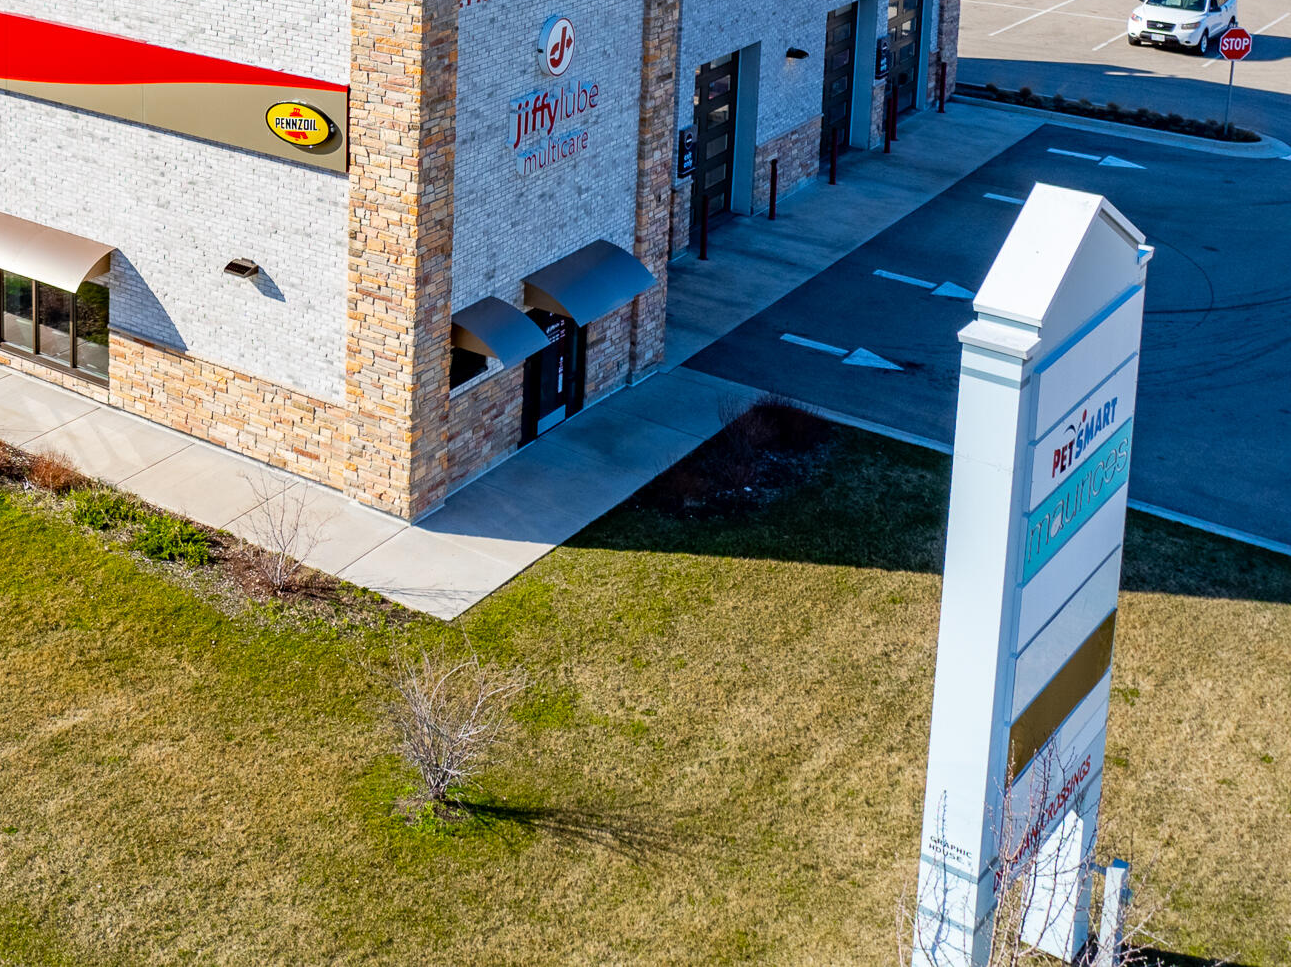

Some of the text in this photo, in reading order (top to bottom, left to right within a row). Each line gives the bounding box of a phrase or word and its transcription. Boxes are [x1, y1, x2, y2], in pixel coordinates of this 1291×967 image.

[1222, 37, 1251, 51] STOP
[275, 117, 318, 132] PENNZOIL
[522, 130, 589, 176] multicare
[1027, 437, 1129, 564] maurices
[929, 835, 973, 859] GRAPHIC
